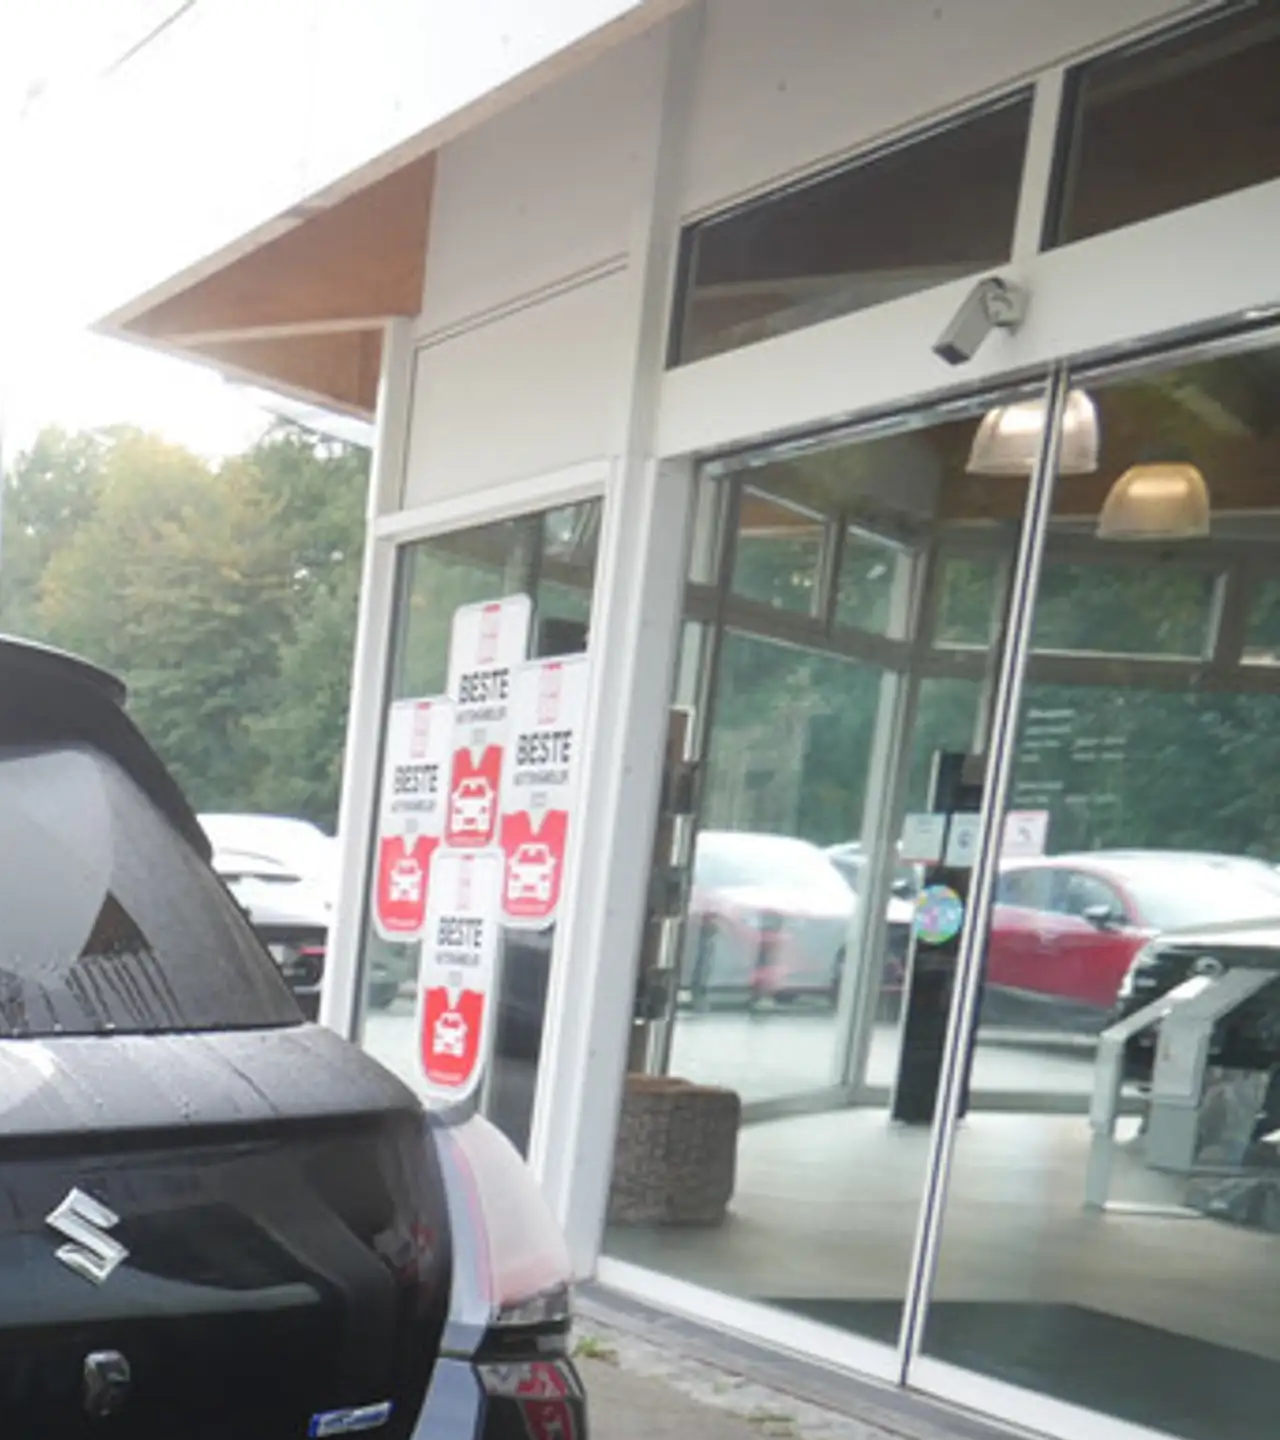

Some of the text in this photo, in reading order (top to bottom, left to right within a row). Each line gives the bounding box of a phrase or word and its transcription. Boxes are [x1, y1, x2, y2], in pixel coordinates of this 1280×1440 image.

[459, 668, 509, 704] BESTE
[517, 729, 572, 765] BESTE
[393, 763, 439, 795] BESTE
[437, 916, 483, 948] BESTE
